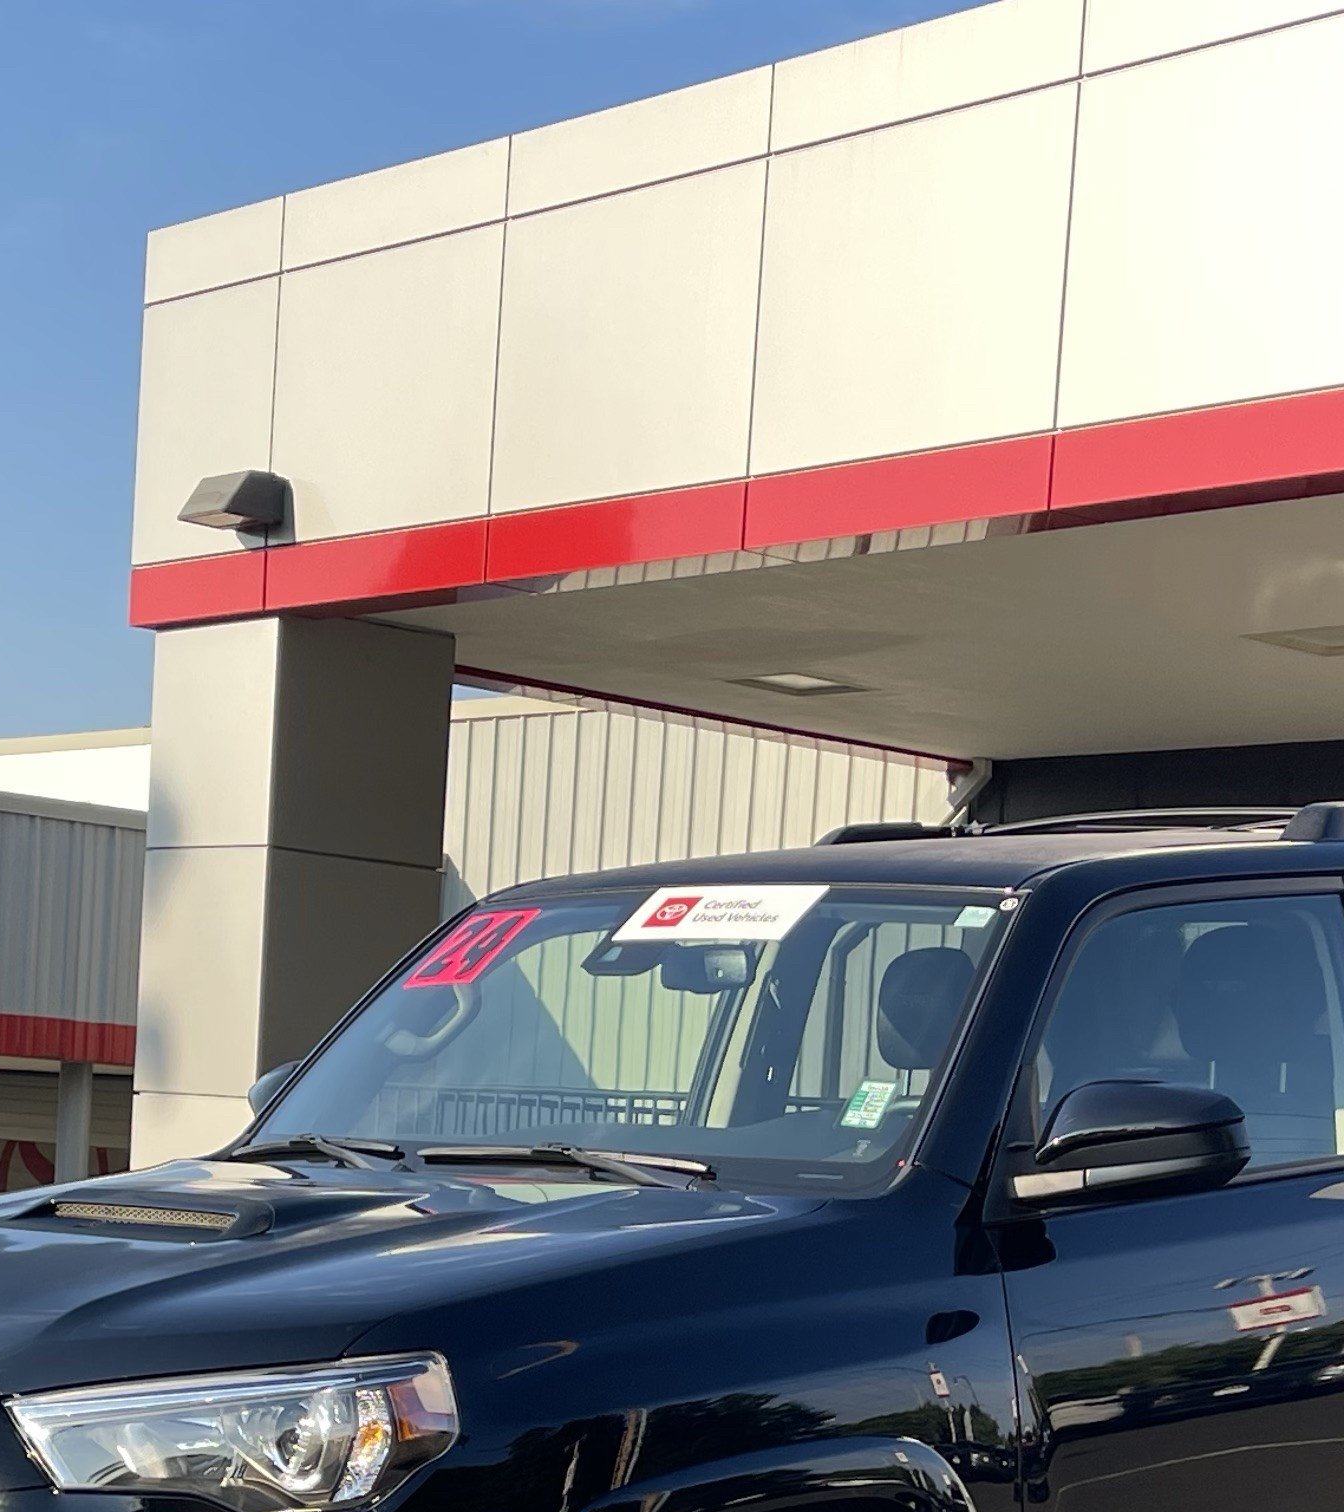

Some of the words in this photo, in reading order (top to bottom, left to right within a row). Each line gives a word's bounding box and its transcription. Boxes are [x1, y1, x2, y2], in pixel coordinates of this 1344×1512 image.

[704, 899, 762, 910] Certified
[692, 912, 726, 922] Used
[726, 912, 780, 923] Vehicles
